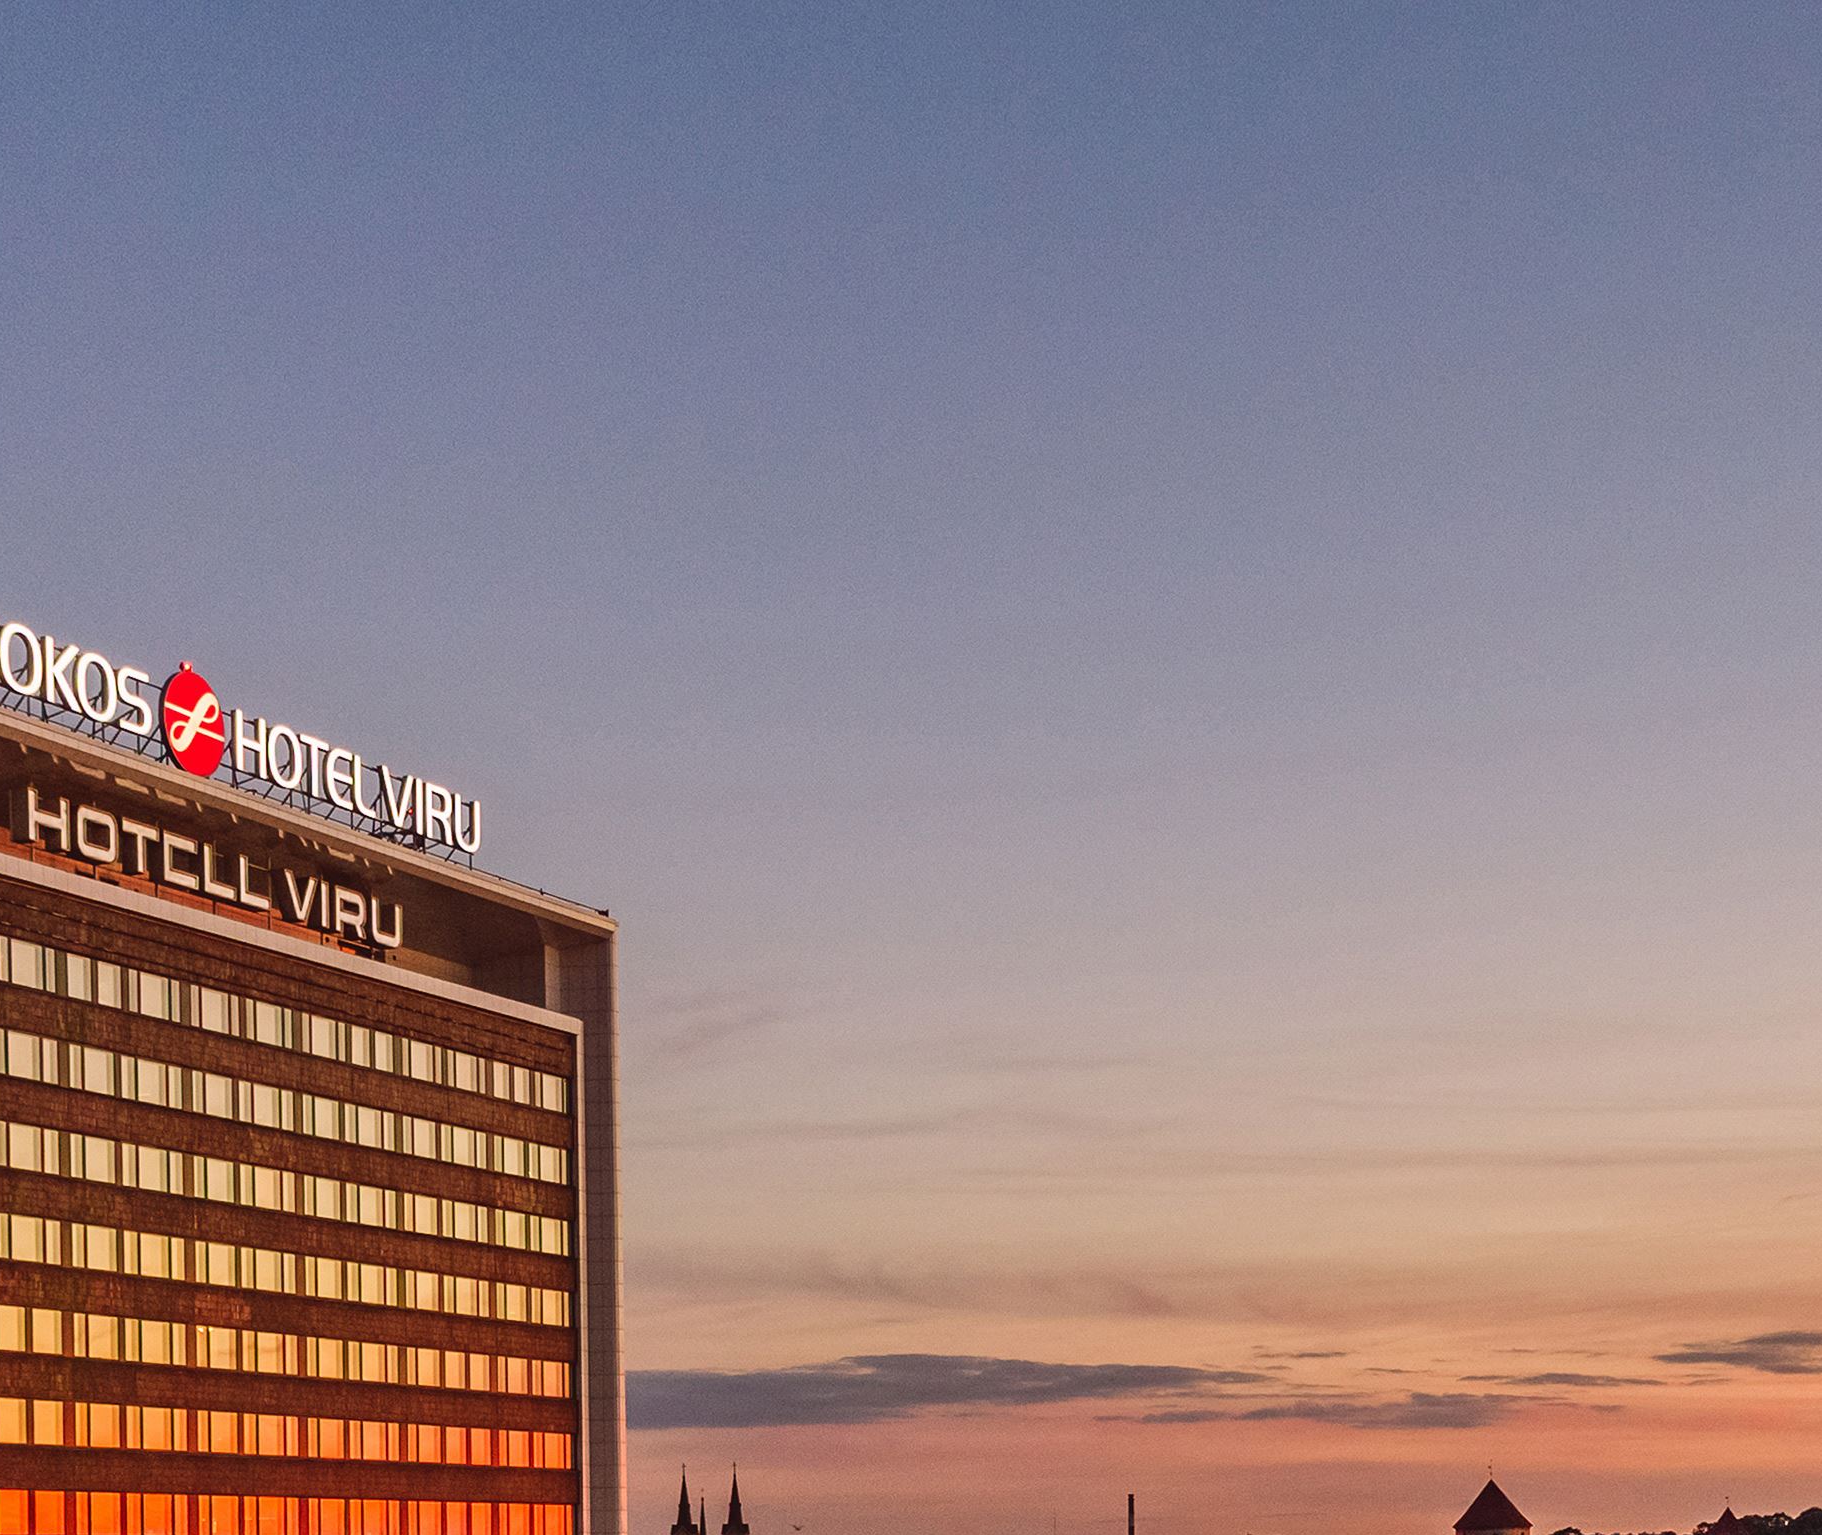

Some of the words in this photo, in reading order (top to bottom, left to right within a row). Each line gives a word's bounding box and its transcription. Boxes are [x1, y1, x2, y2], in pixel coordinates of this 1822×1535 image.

[233, 709, 378, 819] HOTEL
[379, 765, 483, 854] VIRU
[25, 786, 272, 911] HOTELL
[283, 867, 404, 949] VIRU
